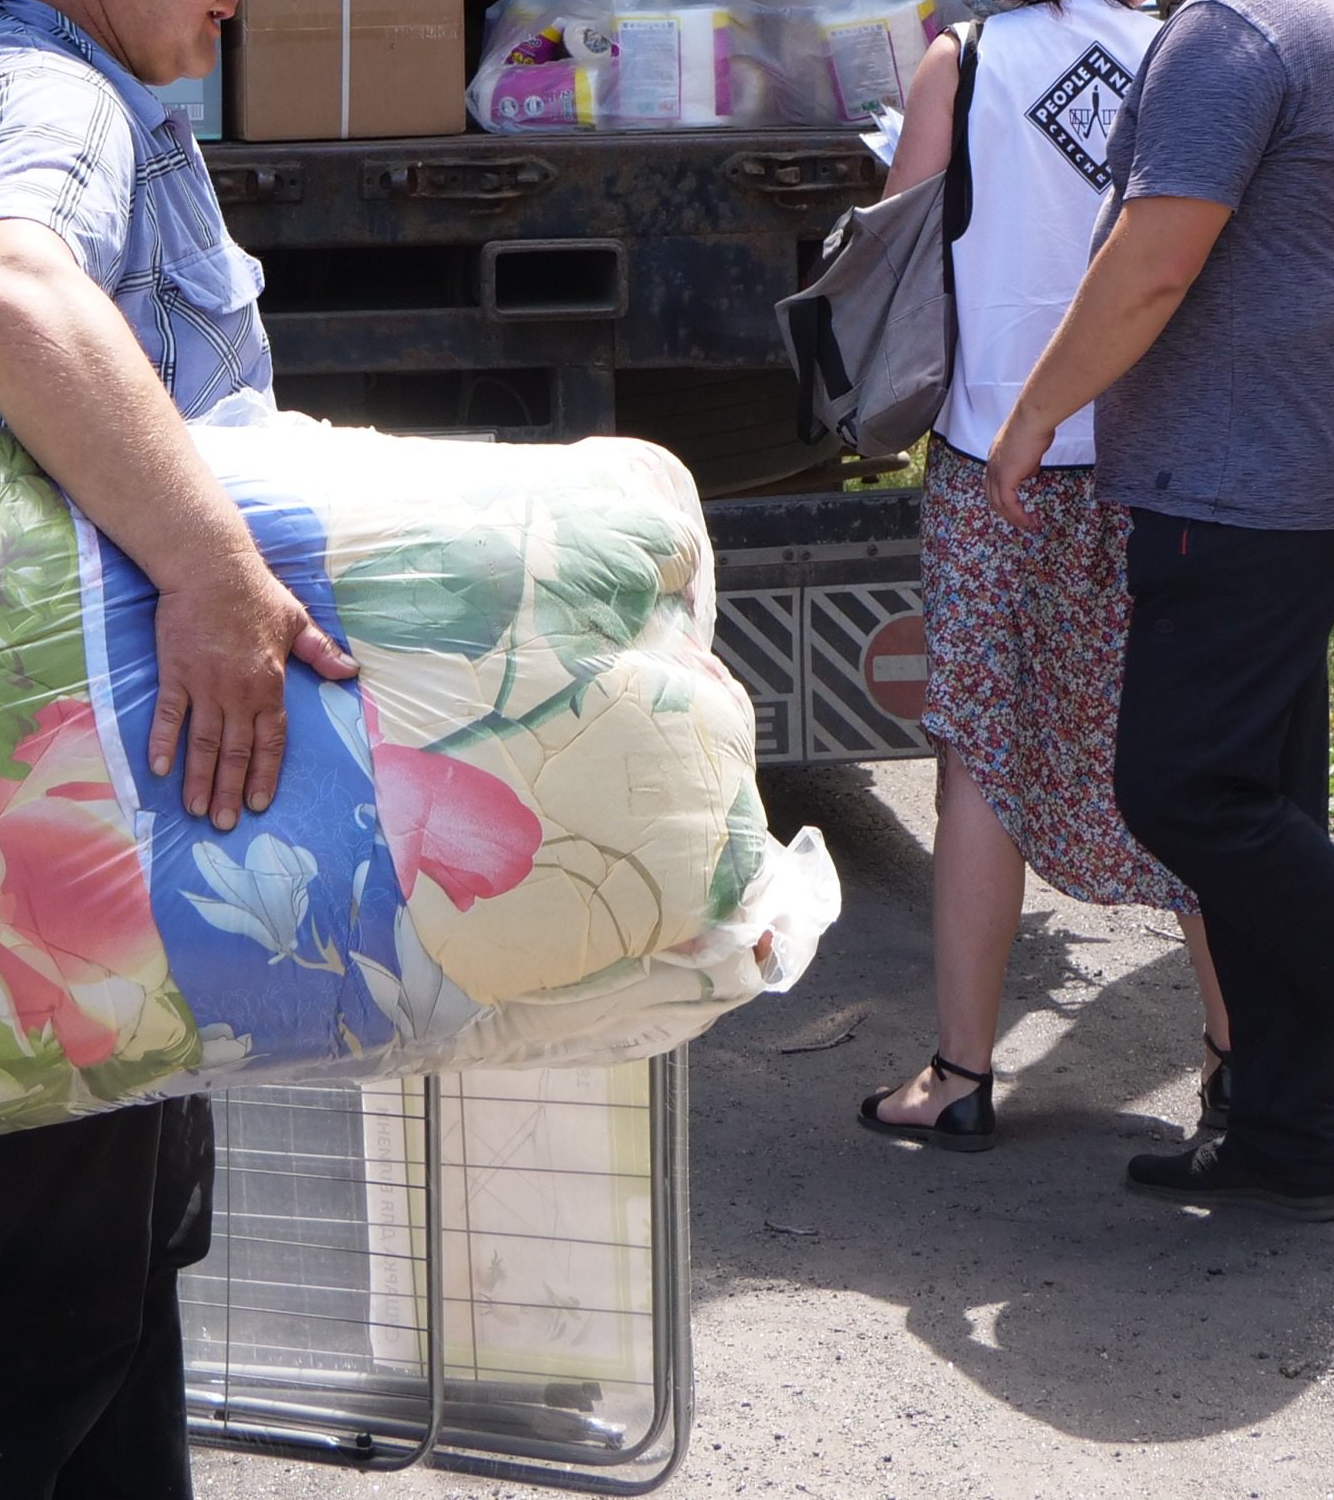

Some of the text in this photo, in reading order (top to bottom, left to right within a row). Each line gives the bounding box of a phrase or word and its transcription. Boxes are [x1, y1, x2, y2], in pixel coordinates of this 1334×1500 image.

[1036, 66, 1091, 122] PEOPLE
[1089, 51, 1111, 75] IN
[1048, 123, 1094, 174] CZECH
